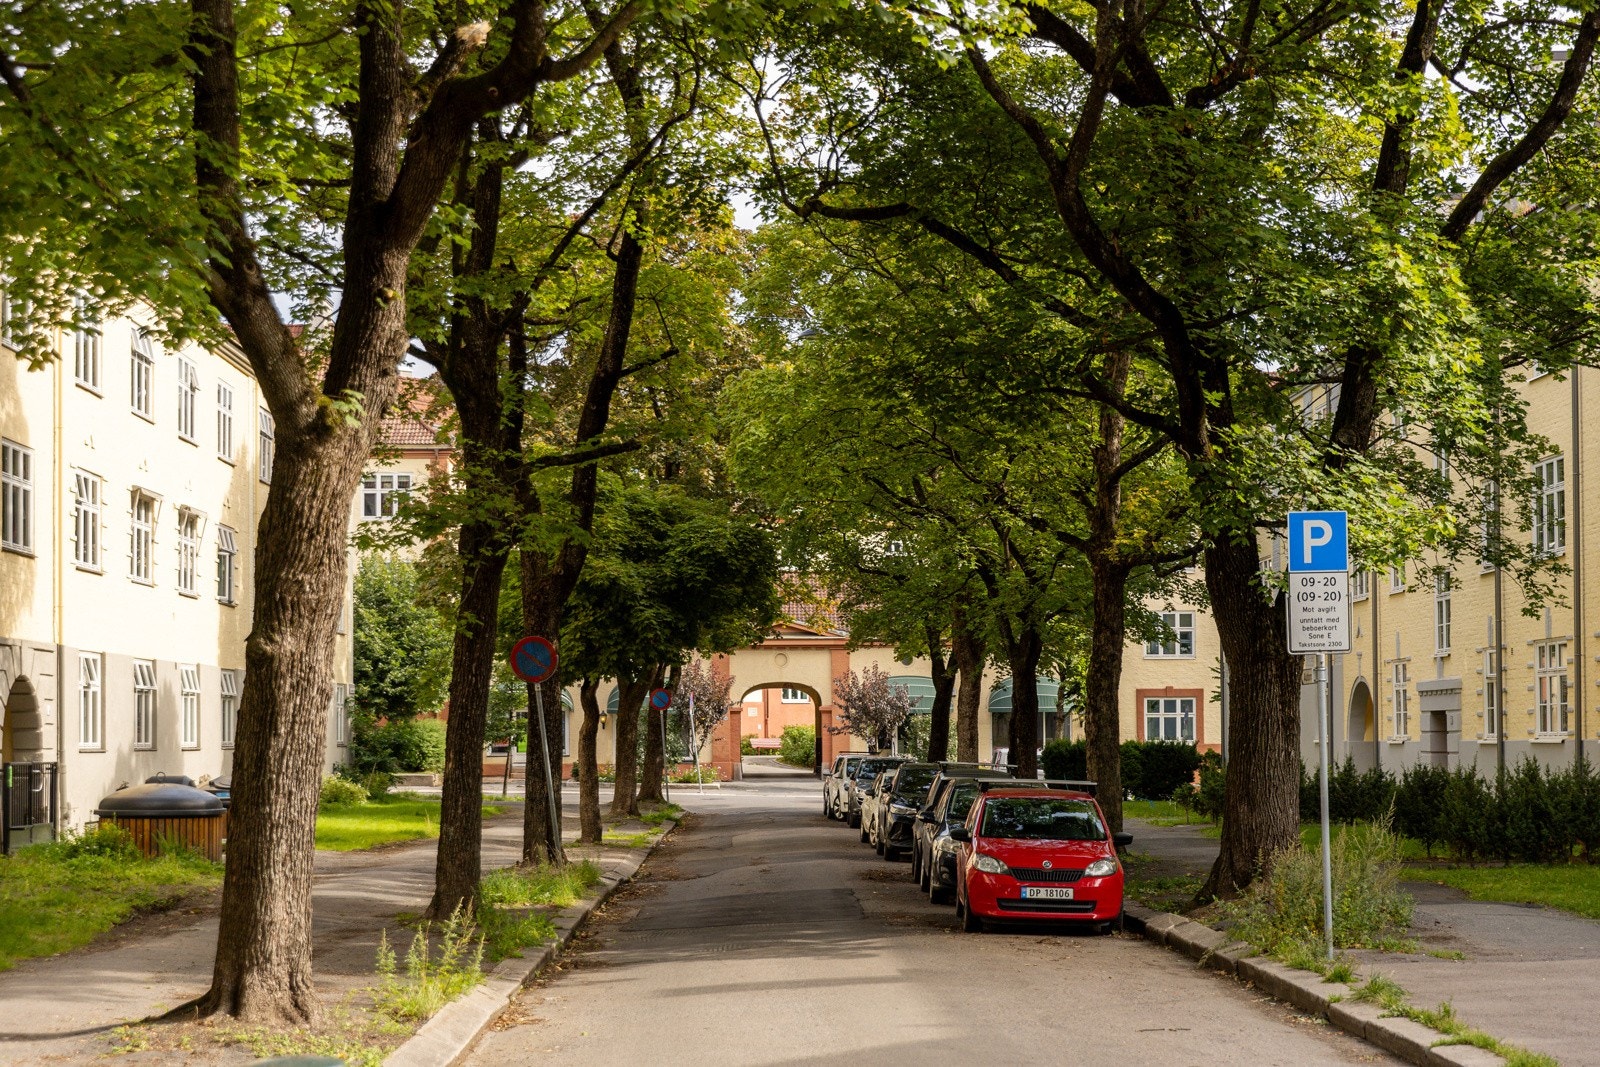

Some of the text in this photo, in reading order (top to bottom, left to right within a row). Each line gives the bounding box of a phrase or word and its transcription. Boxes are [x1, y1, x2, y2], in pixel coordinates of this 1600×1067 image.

[1303, 519, 1333, 564] P
[1317, 606, 1337, 614] avgift
[1029, 888, 1041, 897] DP
[1044, 889, 1070, 898] 18106
